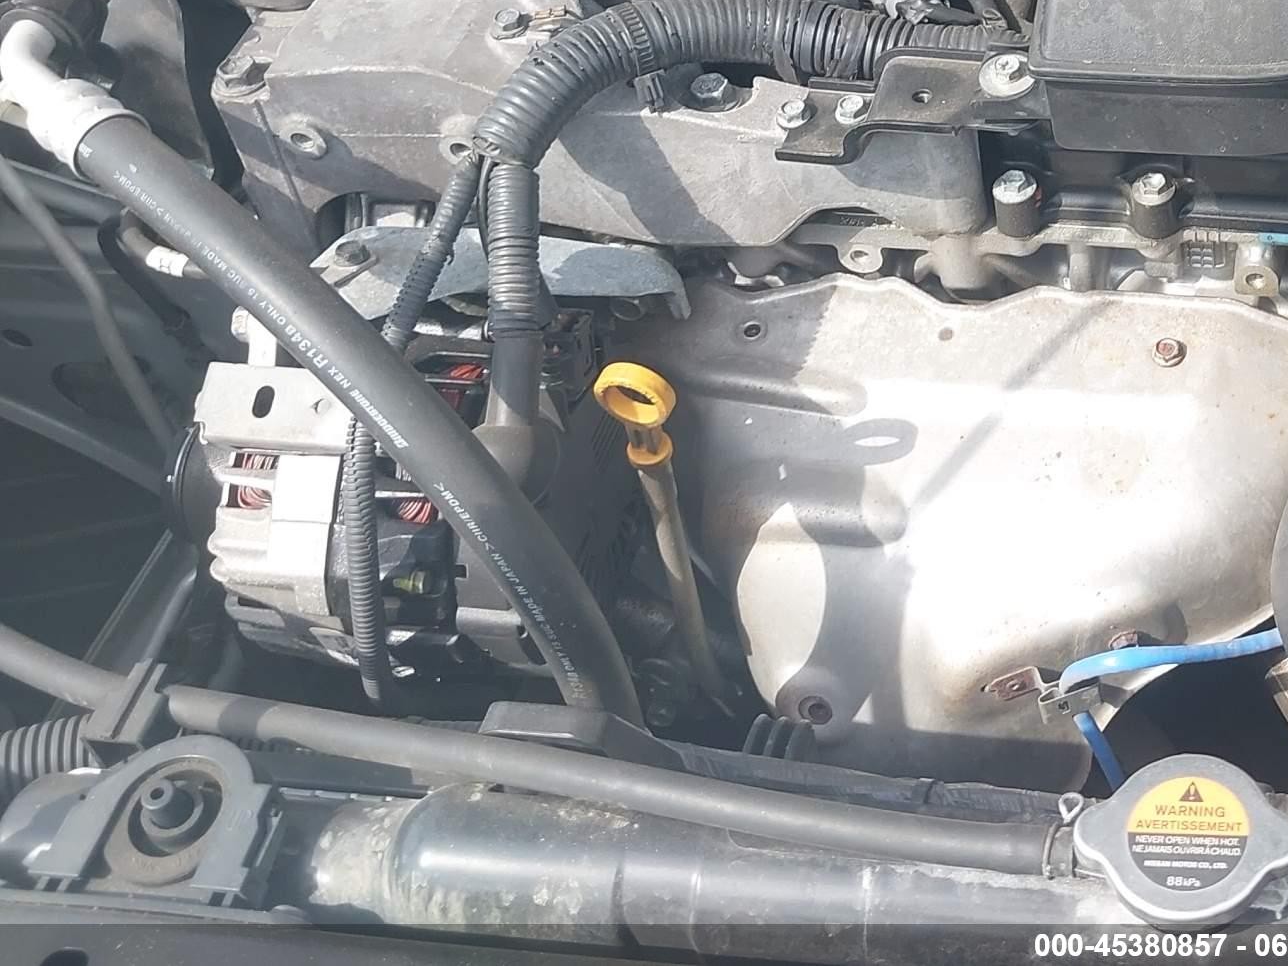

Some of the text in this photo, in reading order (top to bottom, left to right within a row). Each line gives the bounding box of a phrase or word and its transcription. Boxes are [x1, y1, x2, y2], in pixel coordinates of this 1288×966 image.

[258, 298, 287, 325] ONLY
[327, 364, 351, 389] NEX
[489, 549, 520, 586] JAPAN
[522, 595, 546, 623] MADE
[1155, 804, 1225, 818] WARNING
[1136, 820, 1242, 832] AVERTISSEMENT
[1135, 835, 1164, 844] NEVER
[1165, 836, 1190, 844] OPEN
[1191, 836, 1219, 846] WHEN
